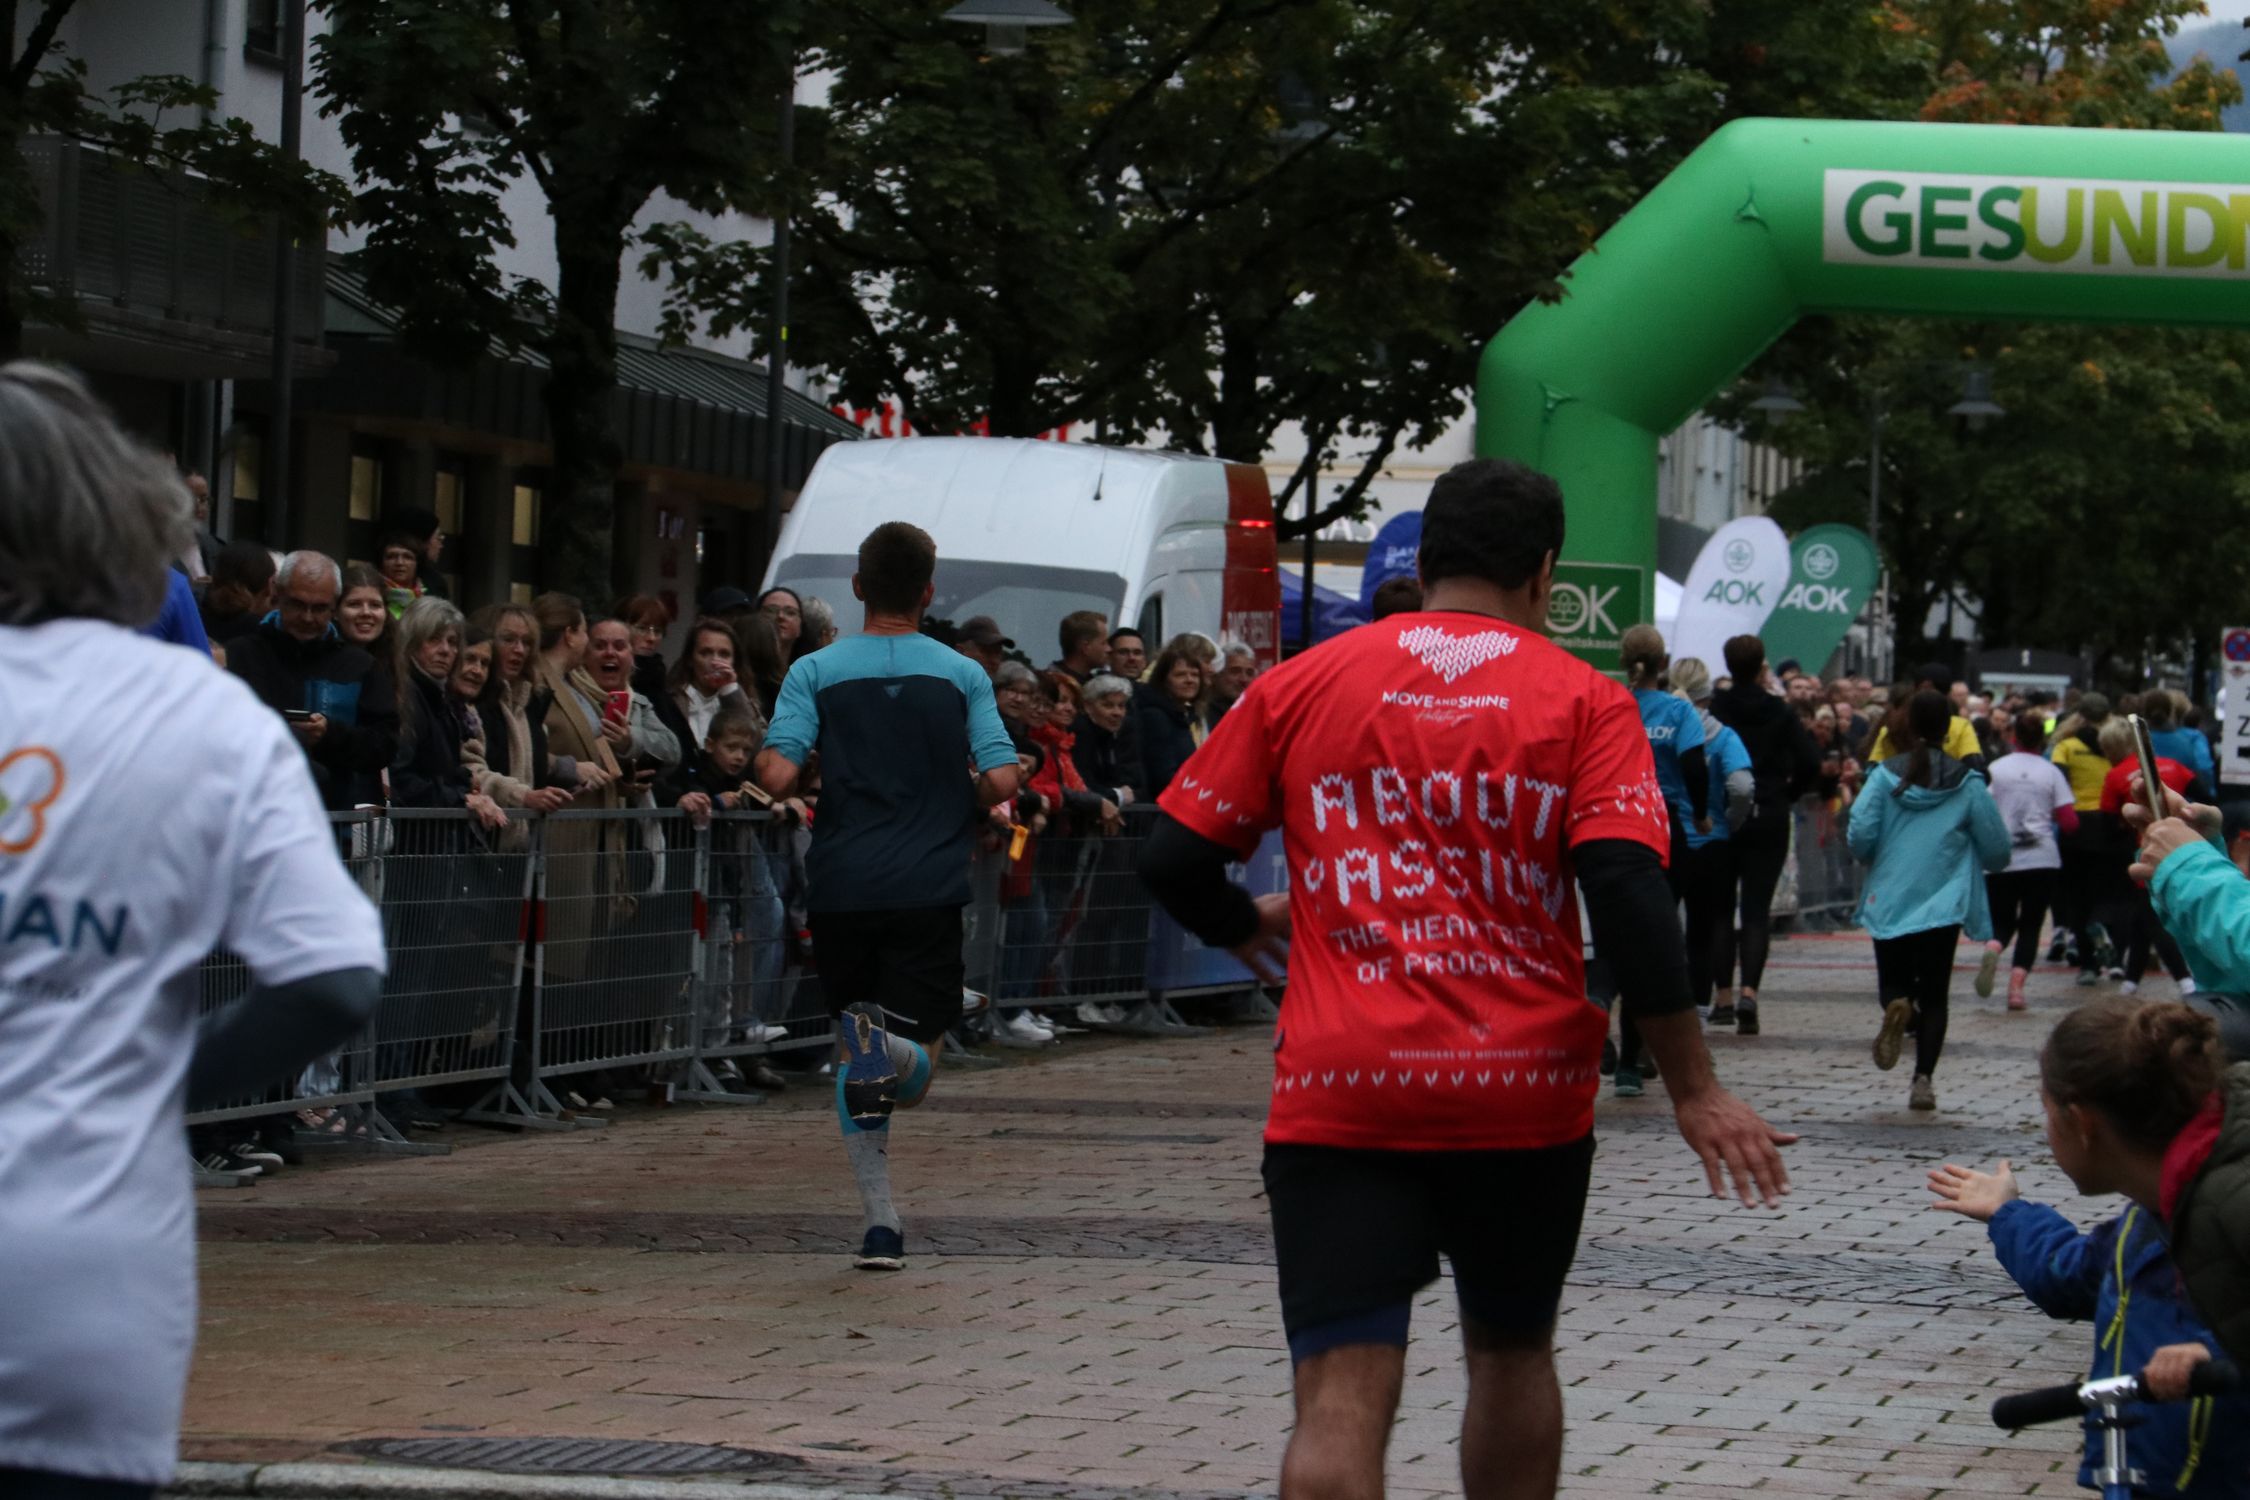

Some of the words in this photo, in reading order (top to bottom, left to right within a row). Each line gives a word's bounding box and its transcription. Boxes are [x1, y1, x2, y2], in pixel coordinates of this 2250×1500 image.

[1703, 579, 1764, 606] AOK
[1780, 583, 1850, 614] AOK
[1545, 583, 1619, 635] OK
[1382, 690, 1434, 708] MOVE
[1434, 698, 1457, 706] AND
[1458, 695, 1510, 710] SHINE
[1645, 726, 1676, 739] LOY
[1311, 766, 1567, 840] ABOUT
[0, 892, 129, 955] AN
[1329, 920, 1388, 954] THE
[1357, 956, 1392, 984] OF
